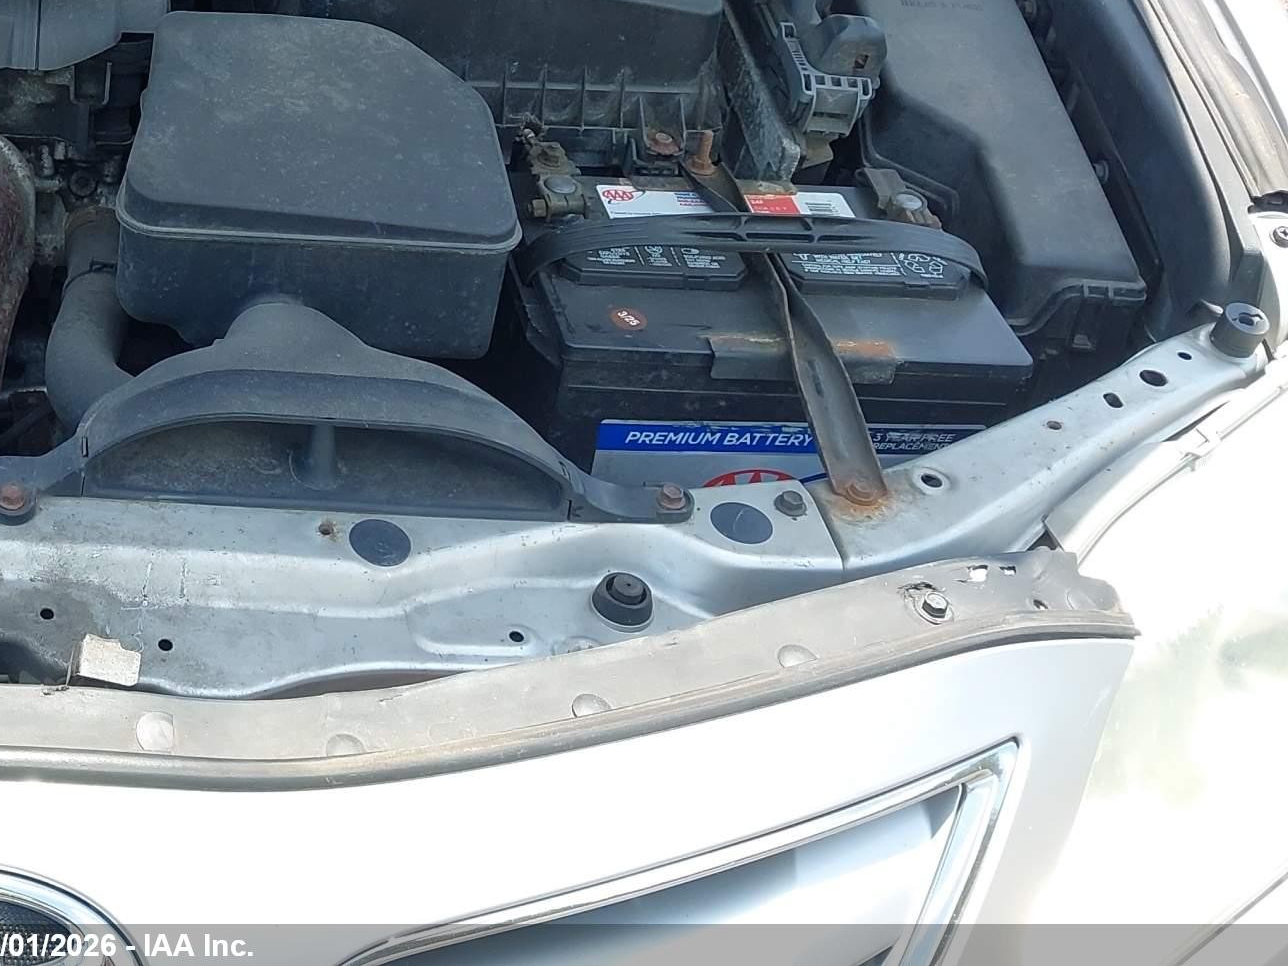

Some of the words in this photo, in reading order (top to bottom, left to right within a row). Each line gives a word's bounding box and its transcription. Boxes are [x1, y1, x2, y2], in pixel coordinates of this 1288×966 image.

[603, 188, 634, 202] AAA
[617, 310, 641, 326] 3/25
[624, 431, 722, 445] PREMIUM
[723, 432, 814, 447] BATTERY
[873, 433, 883, 442] 3
[921, 434, 955, 443] FREE
